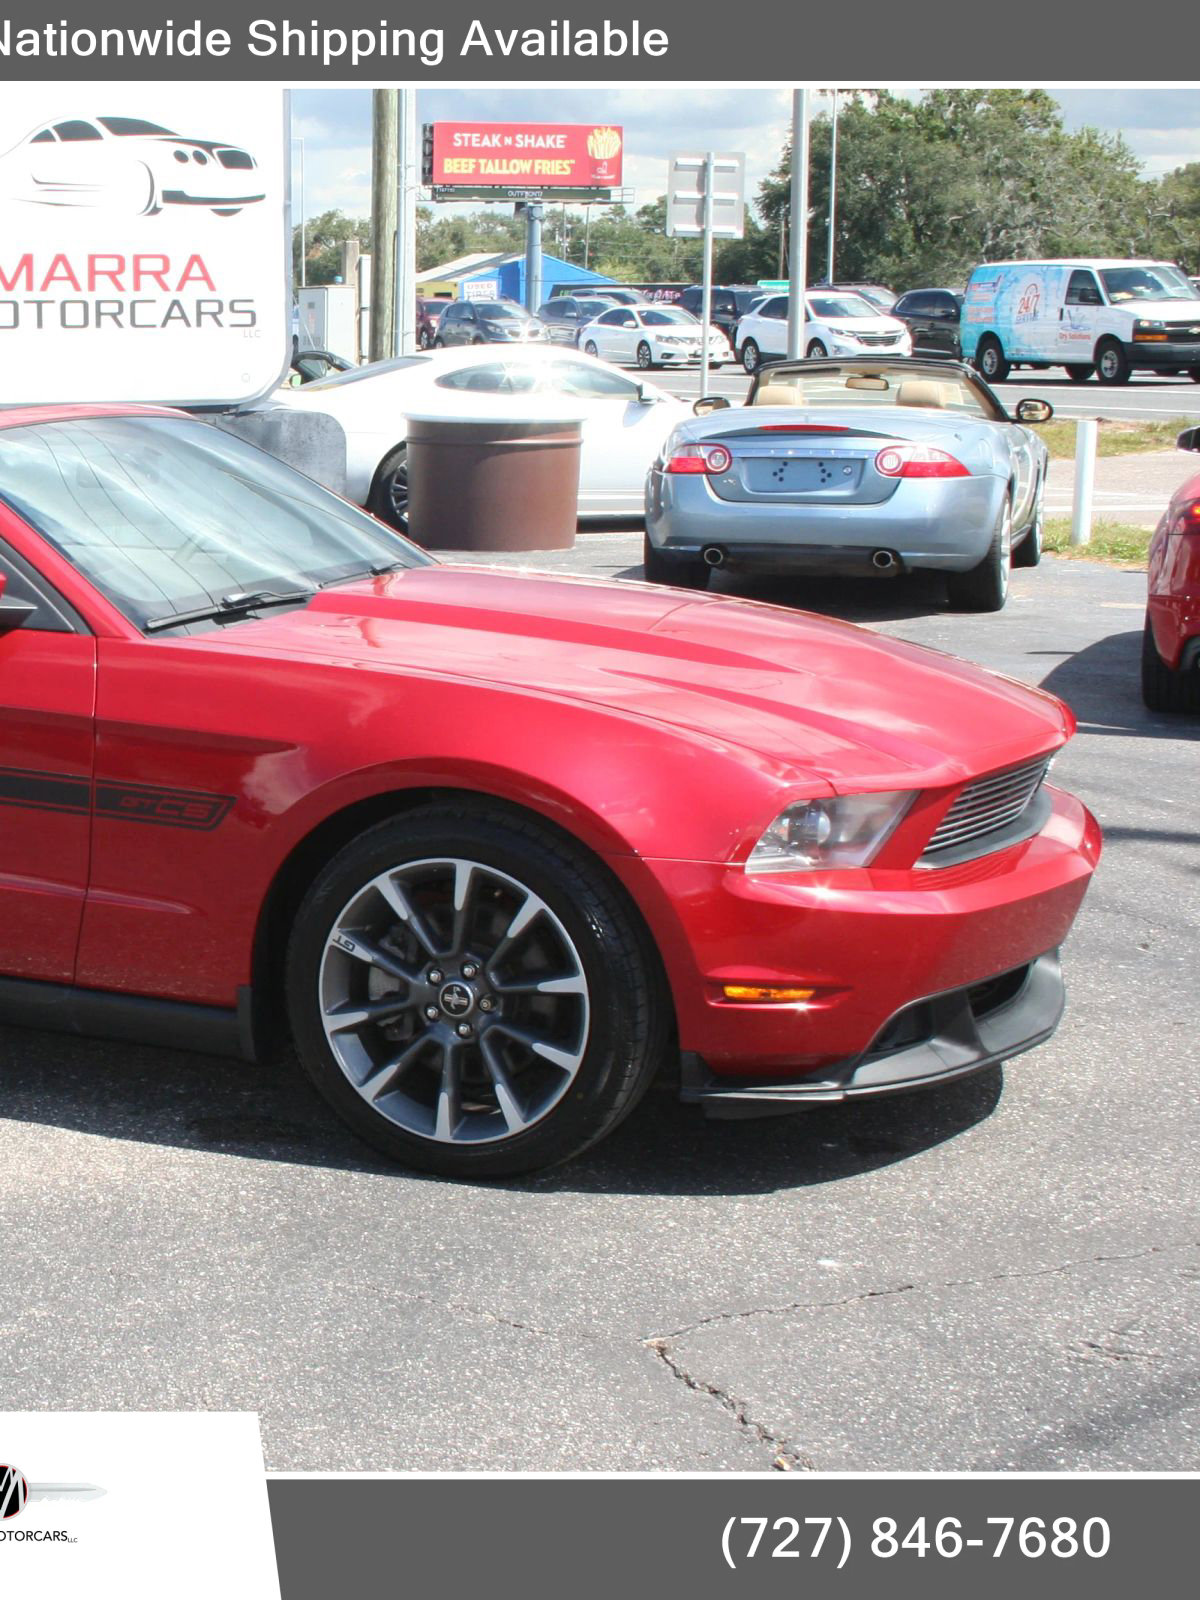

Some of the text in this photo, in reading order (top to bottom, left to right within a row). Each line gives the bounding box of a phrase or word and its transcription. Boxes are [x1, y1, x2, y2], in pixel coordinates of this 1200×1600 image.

[453, 133, 501, 147] STEAK
[515, 134, 567, 148] SHAKE
[443, 158, 476, 174] BEEF
[479, 158, 533, 175] TALLOW
